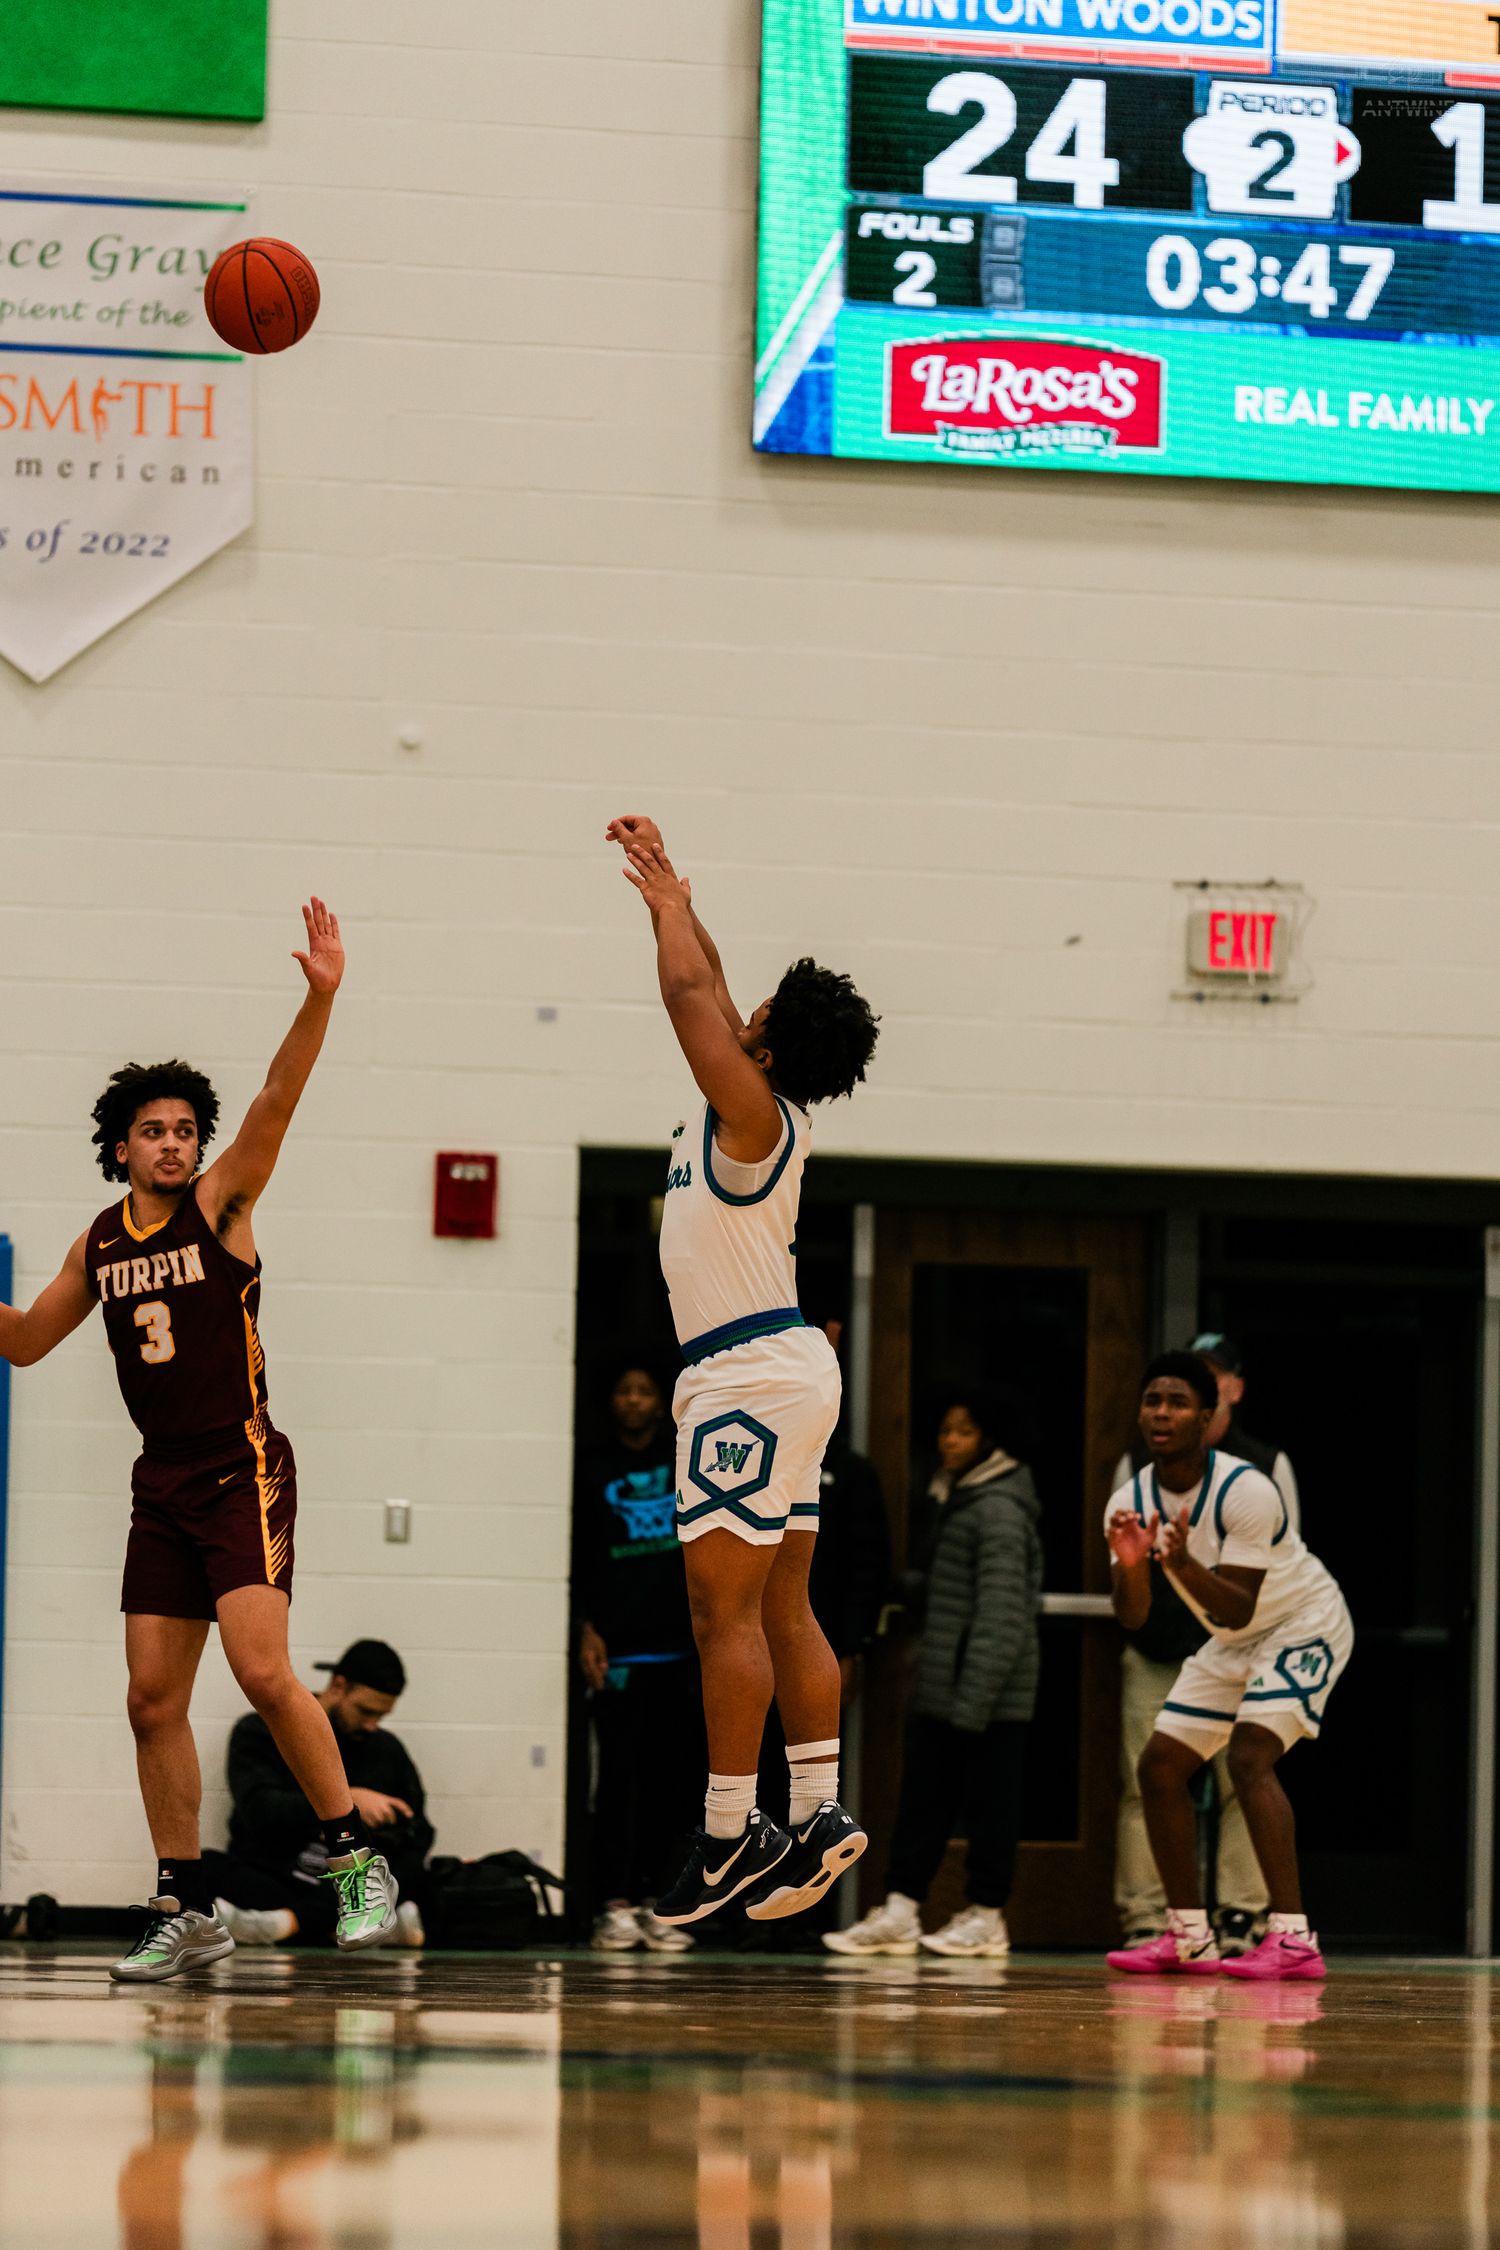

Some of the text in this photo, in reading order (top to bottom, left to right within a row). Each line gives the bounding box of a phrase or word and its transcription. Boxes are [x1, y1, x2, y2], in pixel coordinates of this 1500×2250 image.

[1077, 0, 1263, 41] WOODS
[1219, 91, 1326, 117] PERIOD
[923, 71, 1120, 209] 24
[1247, 129, 1296, 201] 2
[858, 211, 974, 244] FOULS
[0, 239, 64, 269] ce
[892, 250, 937, 308] 2
[1146, 234, 1395, 321] 03:47
[96, 299, 135, 329] of
[138, 301, 192, 326] the
[1235, 385, 1495, 436] REAL FAMILY
[15, 453, 220, 485] merican
[25, 519, 71, 563] of
[79, 531, 170, 557] 2022
[1209, 911, 1277, 972] EXIT
[96, 1243, 206, 1303] TURPIN
[133, 1300, 176, 1364] 3
